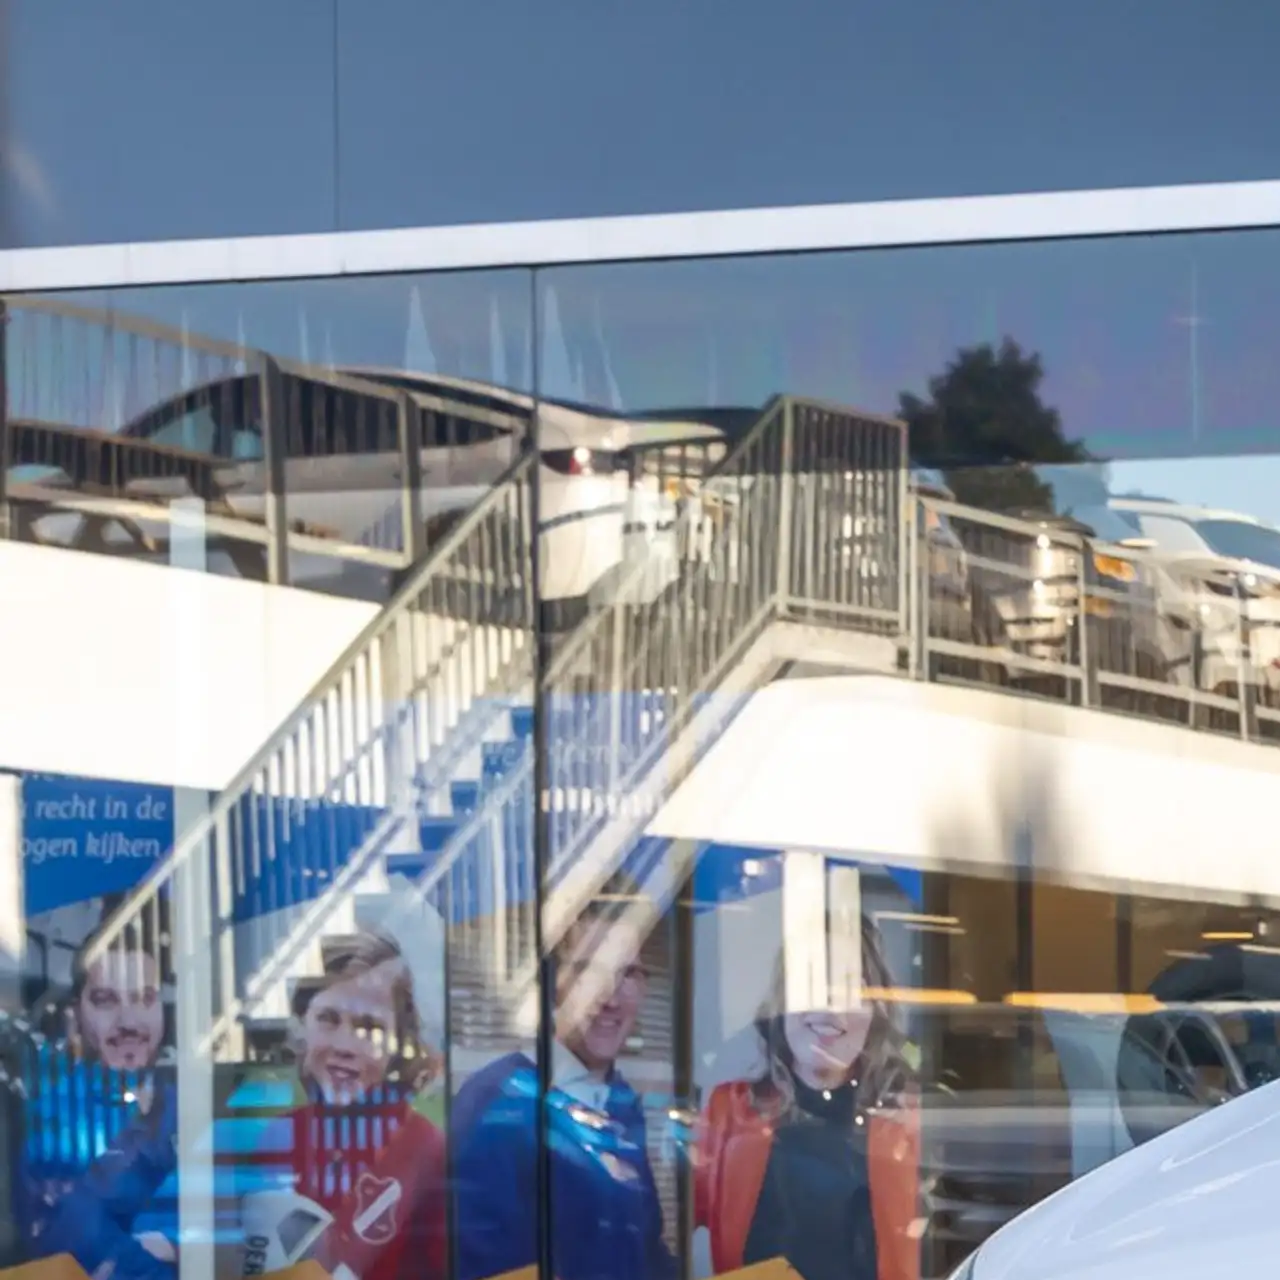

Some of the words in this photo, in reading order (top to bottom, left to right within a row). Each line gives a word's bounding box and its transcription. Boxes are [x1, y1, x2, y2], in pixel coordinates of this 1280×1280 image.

[34, 793, 96, 820] recht
[104, 795, 128, 819] in
[136, 795, 166, 820] de
[85, 831, 161, 864] kijken
